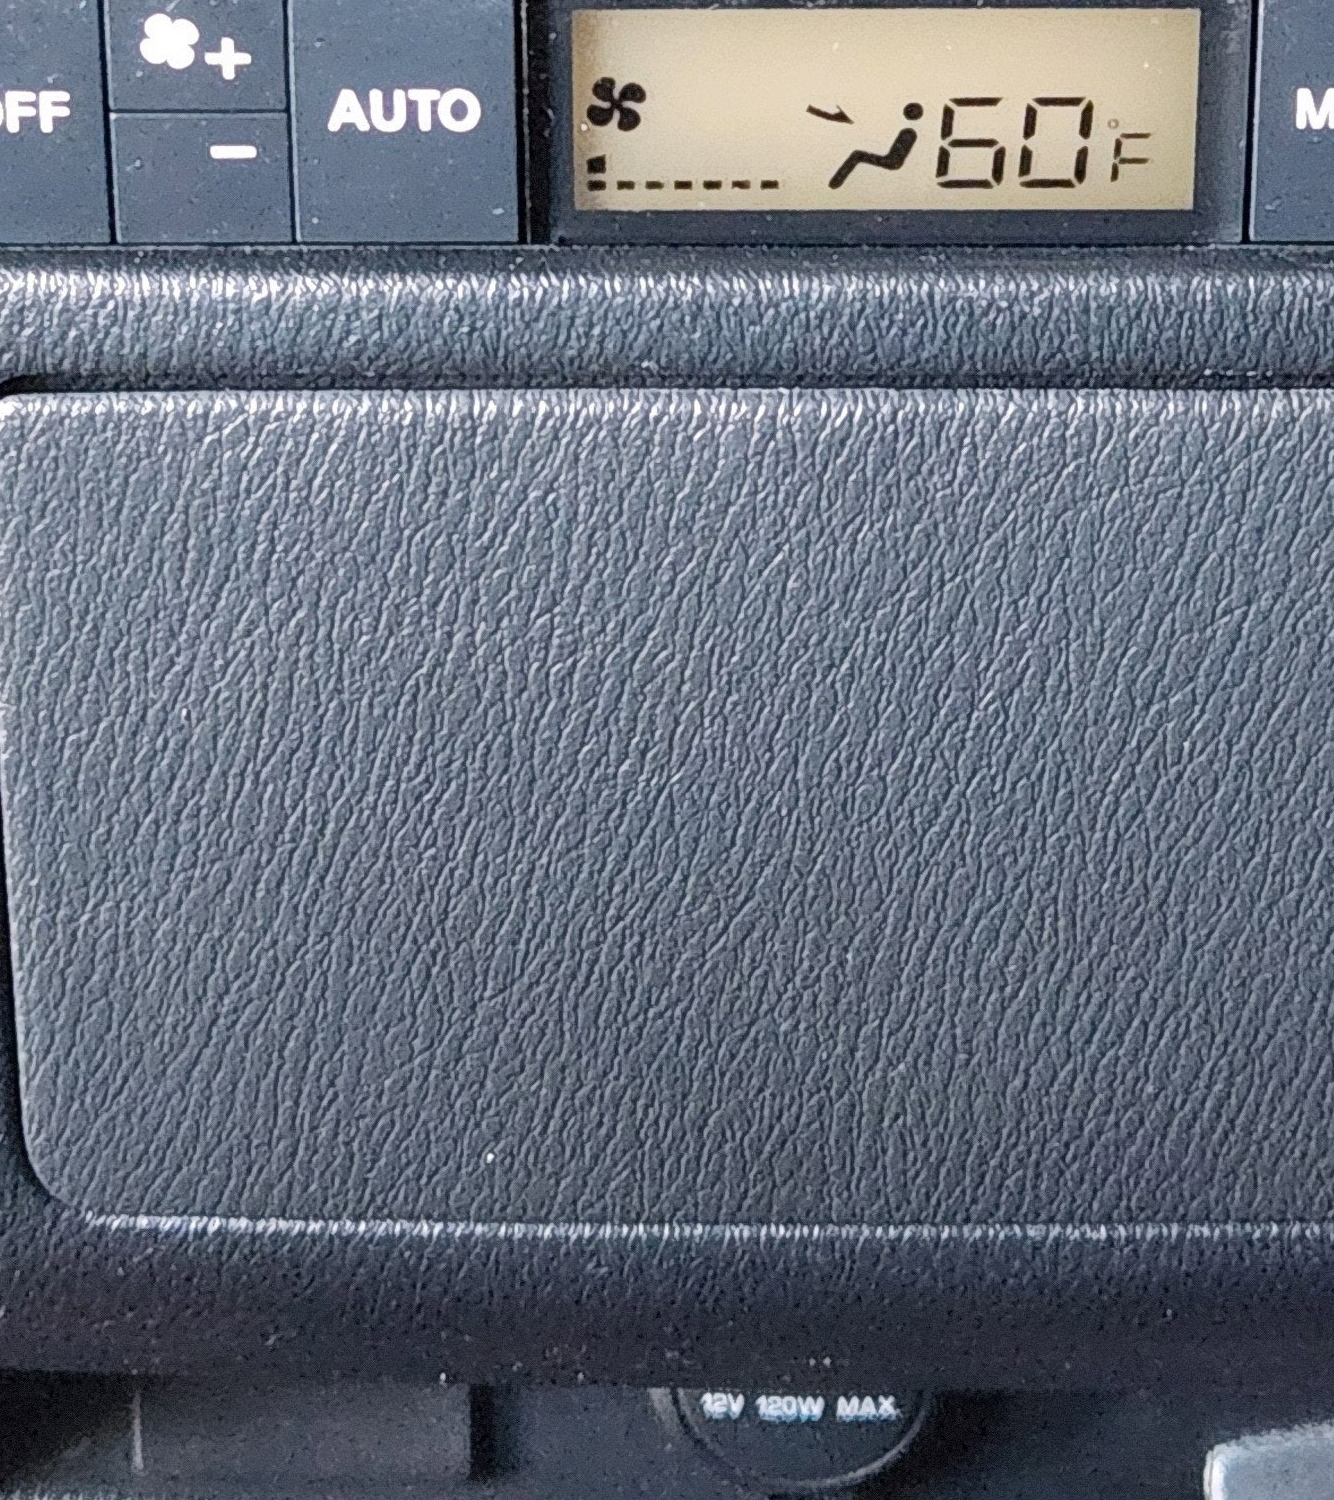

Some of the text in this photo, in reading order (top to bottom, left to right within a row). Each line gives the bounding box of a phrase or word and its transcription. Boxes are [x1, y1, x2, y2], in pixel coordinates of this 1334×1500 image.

[327, 88, 482, 133] AUTO
[700, 1392, 745, 1419] 12V
[755, 1394, 825, 1422] 120W
